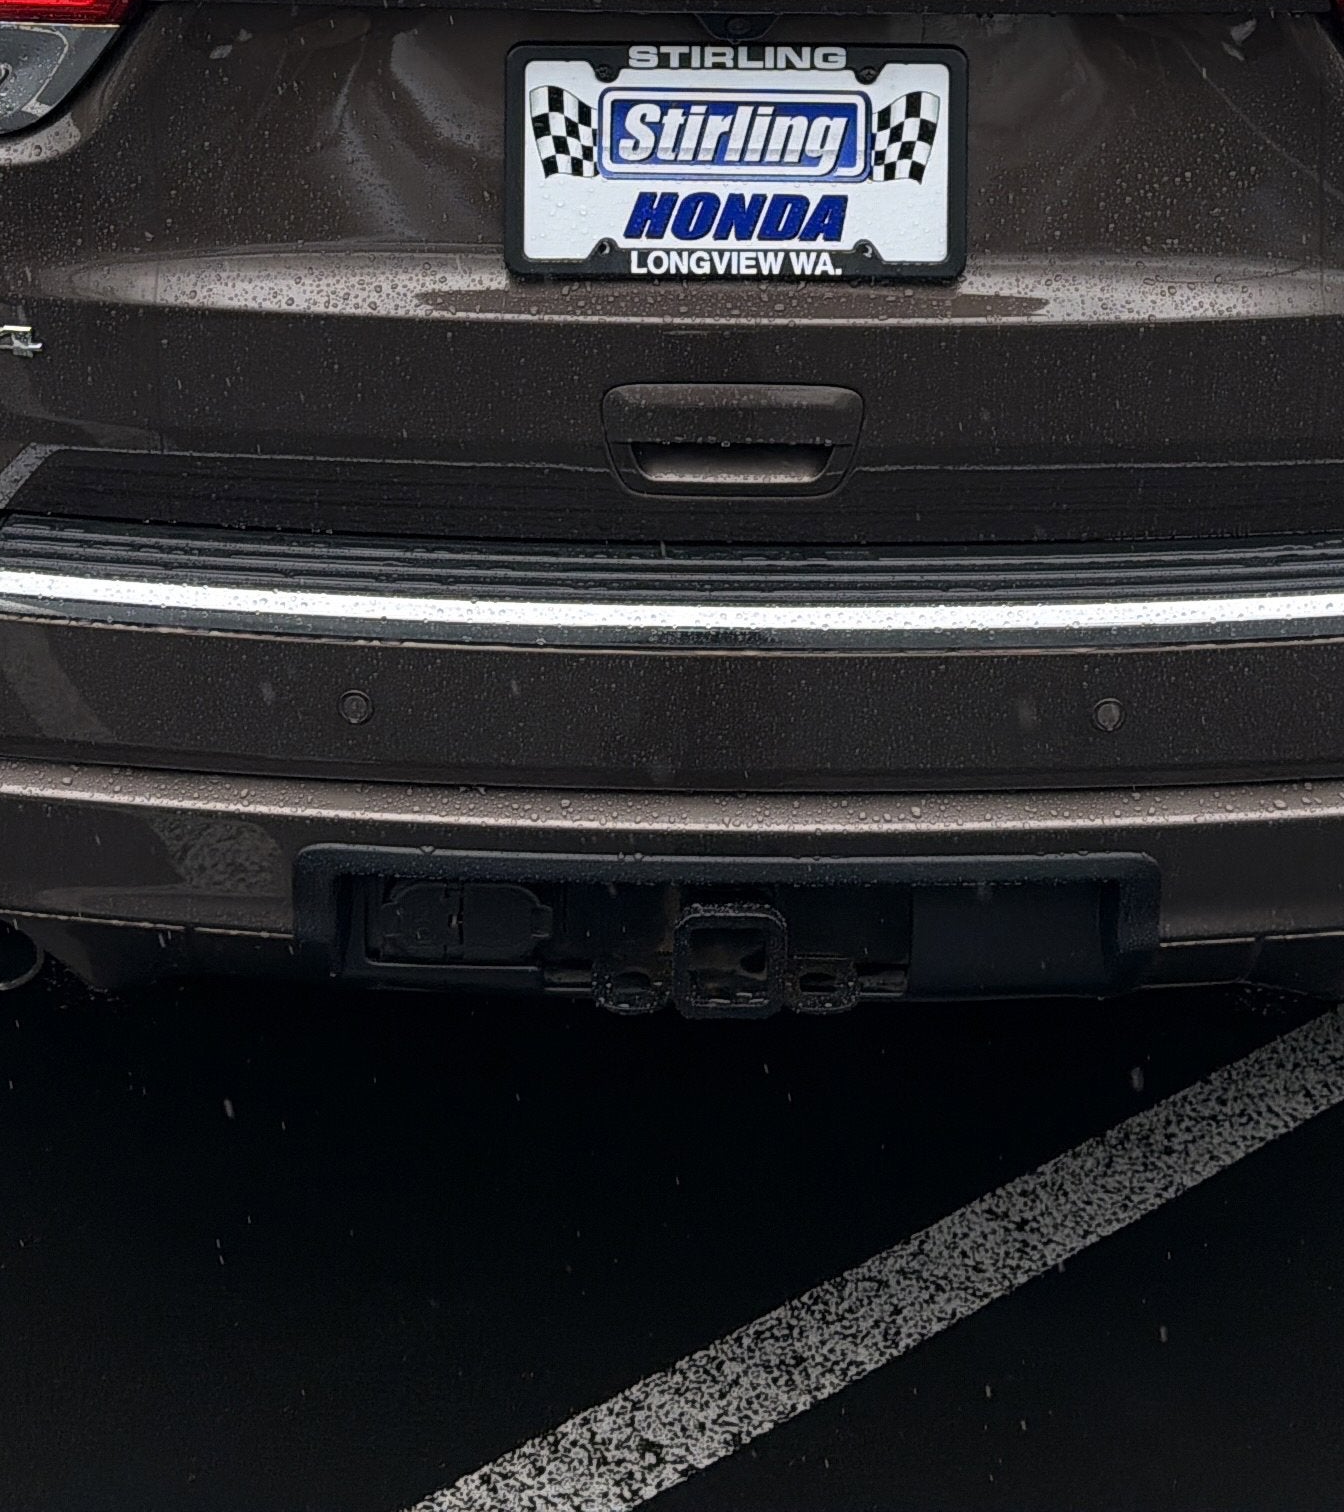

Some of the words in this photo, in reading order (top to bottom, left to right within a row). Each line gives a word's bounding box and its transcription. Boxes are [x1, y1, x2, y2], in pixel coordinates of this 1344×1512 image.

[628, 45, 847, 70] STIRLING
[618, 103, 849, 172] Stirling
[623, 191, 849, 242] HONDA
[630, 251, 785, 275] LONGVIEW
[789, 252, 843, 275] WA.
